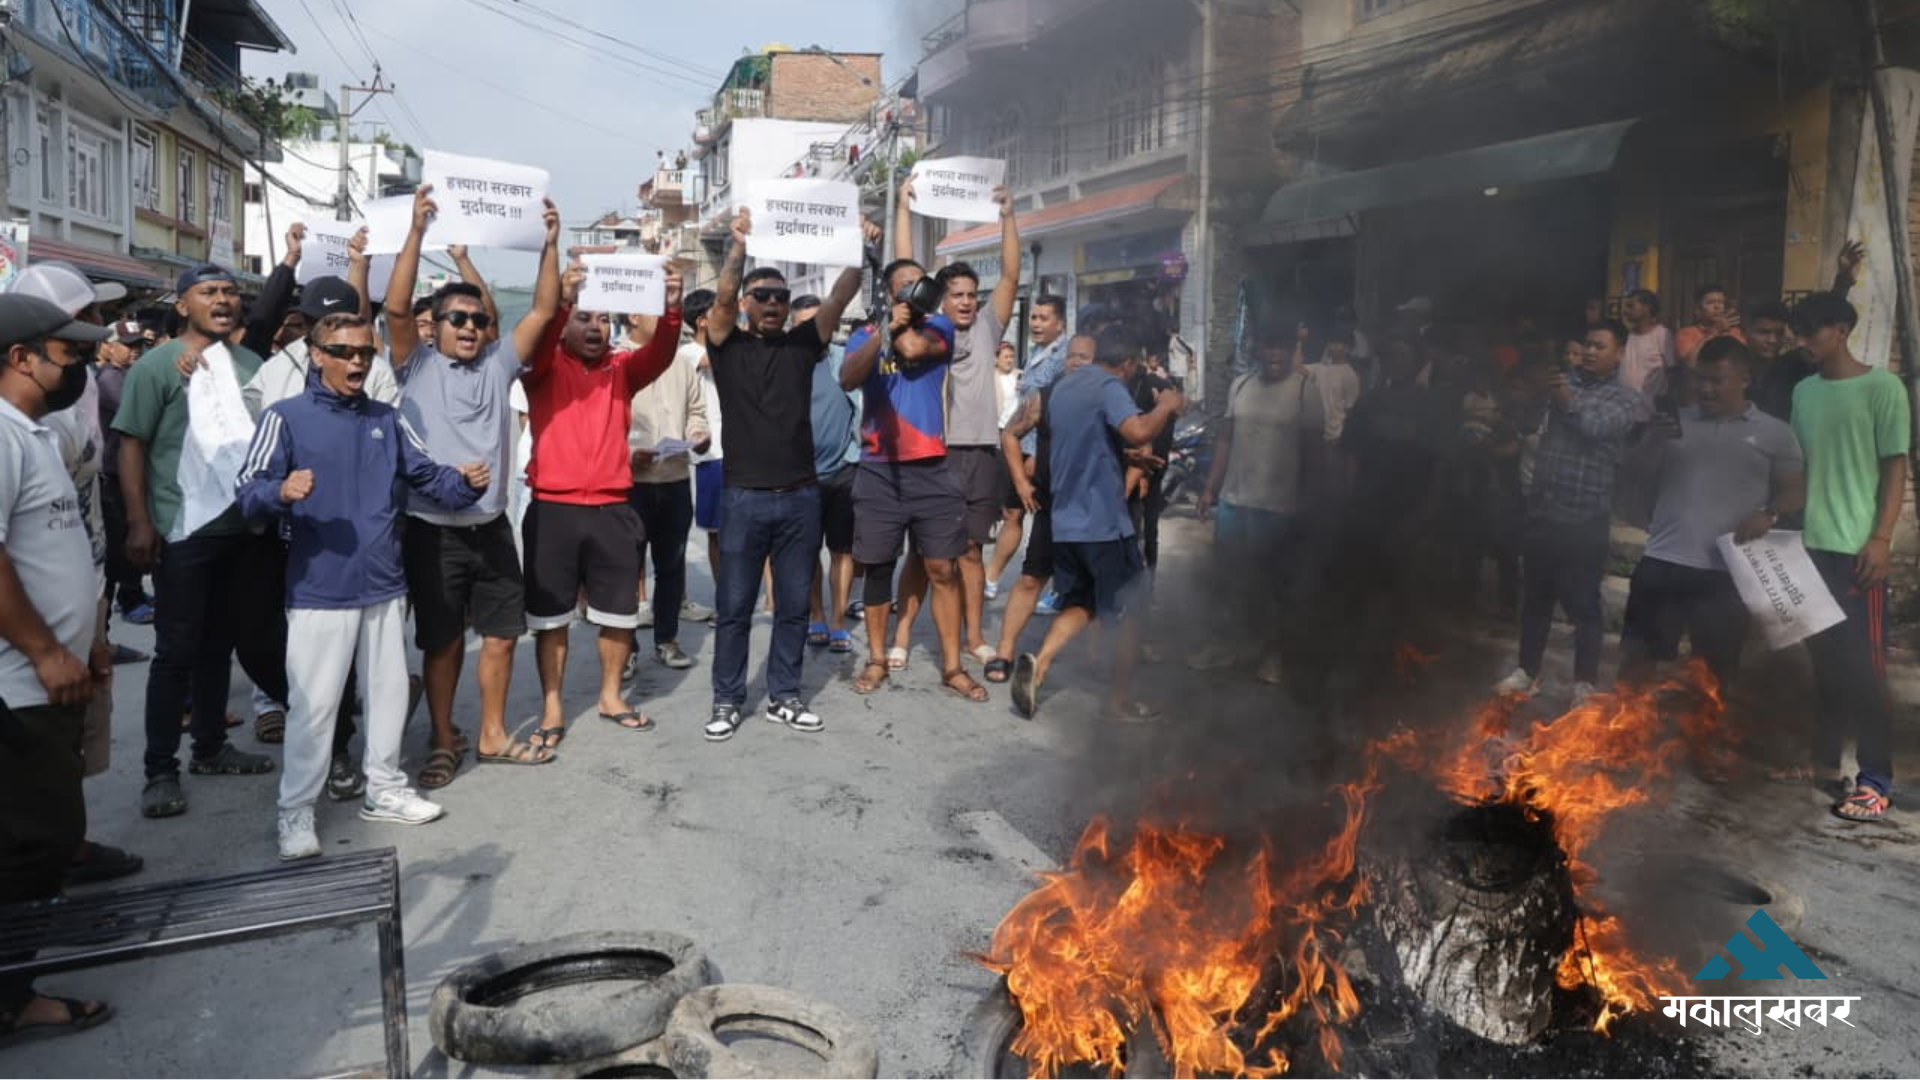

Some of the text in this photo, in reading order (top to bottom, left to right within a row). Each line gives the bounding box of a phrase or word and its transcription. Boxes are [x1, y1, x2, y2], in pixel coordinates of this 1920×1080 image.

[490, 181, 533, 198] सरकार
[509, 206, 522, 220] !!!
[808, 202, 848, 217] सरकार
[822, 225, 834, 237] !!!
